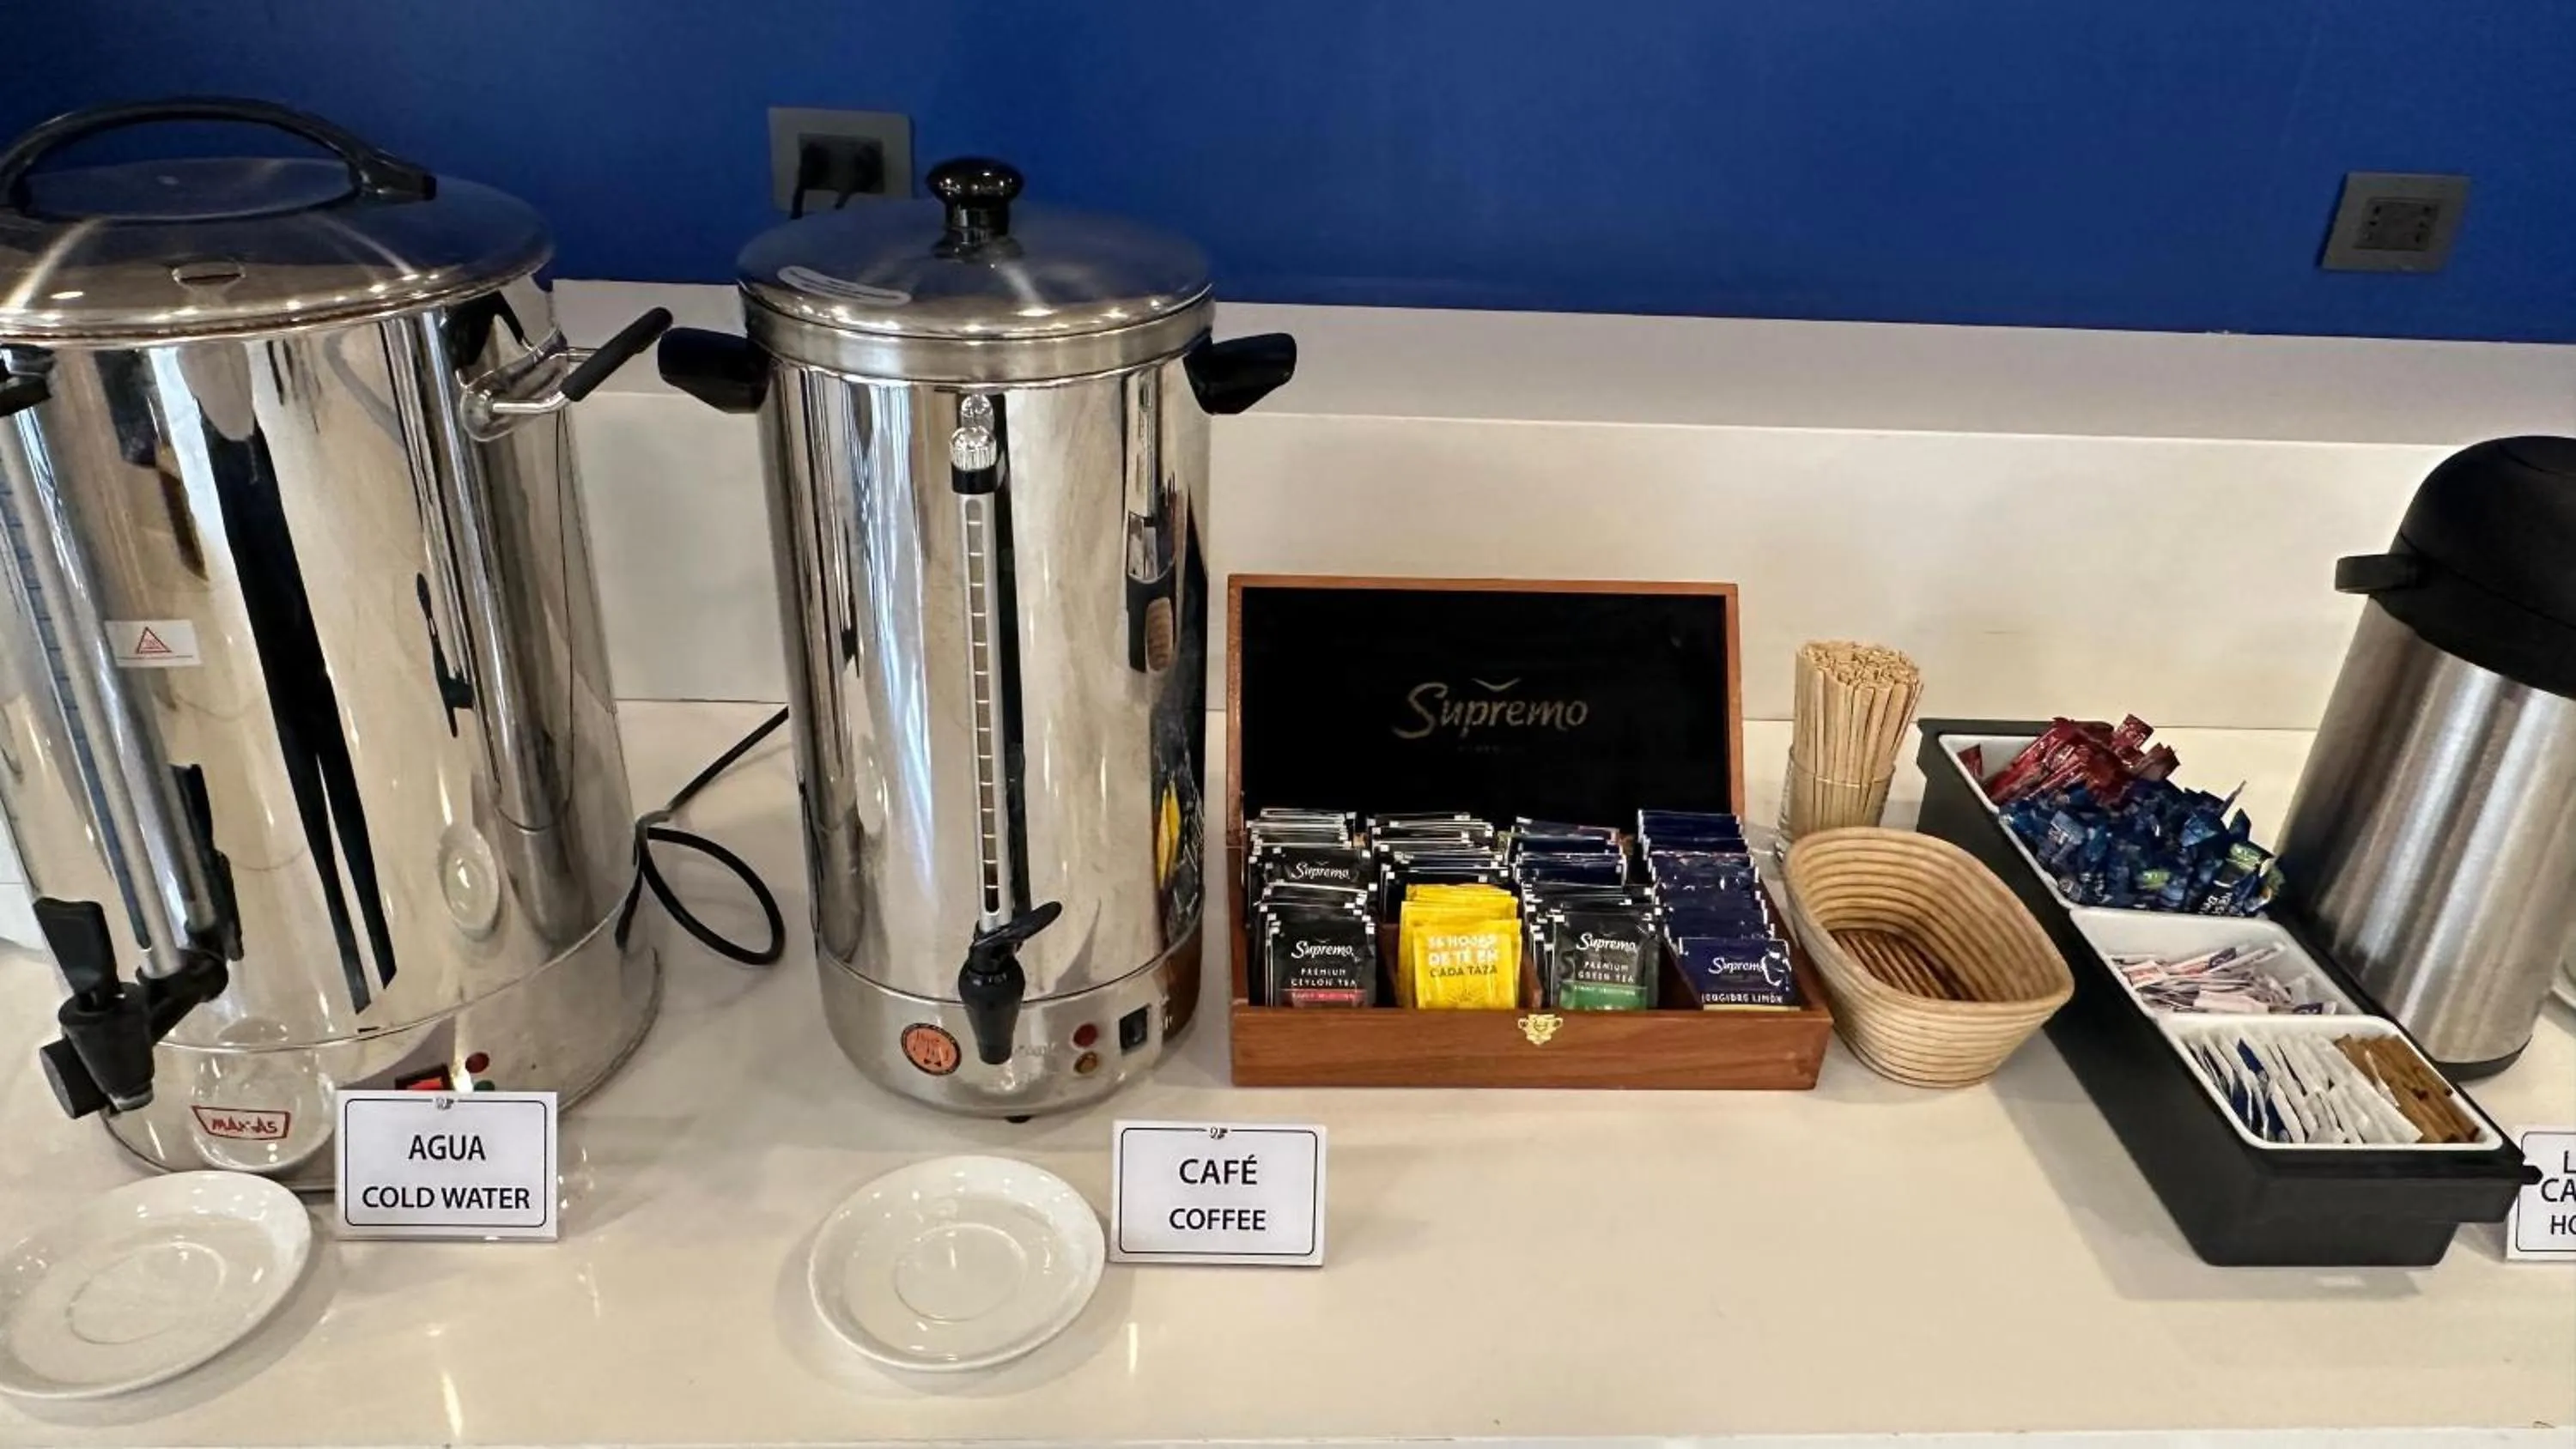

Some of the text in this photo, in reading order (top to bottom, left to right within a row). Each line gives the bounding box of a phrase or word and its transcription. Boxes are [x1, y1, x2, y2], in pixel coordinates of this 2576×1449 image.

[1390, 681, 1589, 739] Supremo
[1291, 861, 1350, 880] Supremo
[1291, 940, 1353, 959] Supremo
[1576, 931, 1637, 951] Supremo
[1301, 967, 1346, 976] PREMIUM
[1429, 965, 1498, 978] CADA TAZA
[1583, 961, 1629, 972] PREMIUM
[1577, 970, 1635, 984] GREEN TEA
[408, 1134, 487, 1161] AGUA
[1179, 1154, 1258, 1185] CAFÉ
[361, 1185, 531, 1210] COLD WATER
[1169, 1208, 1267, 1231] COFFEE
